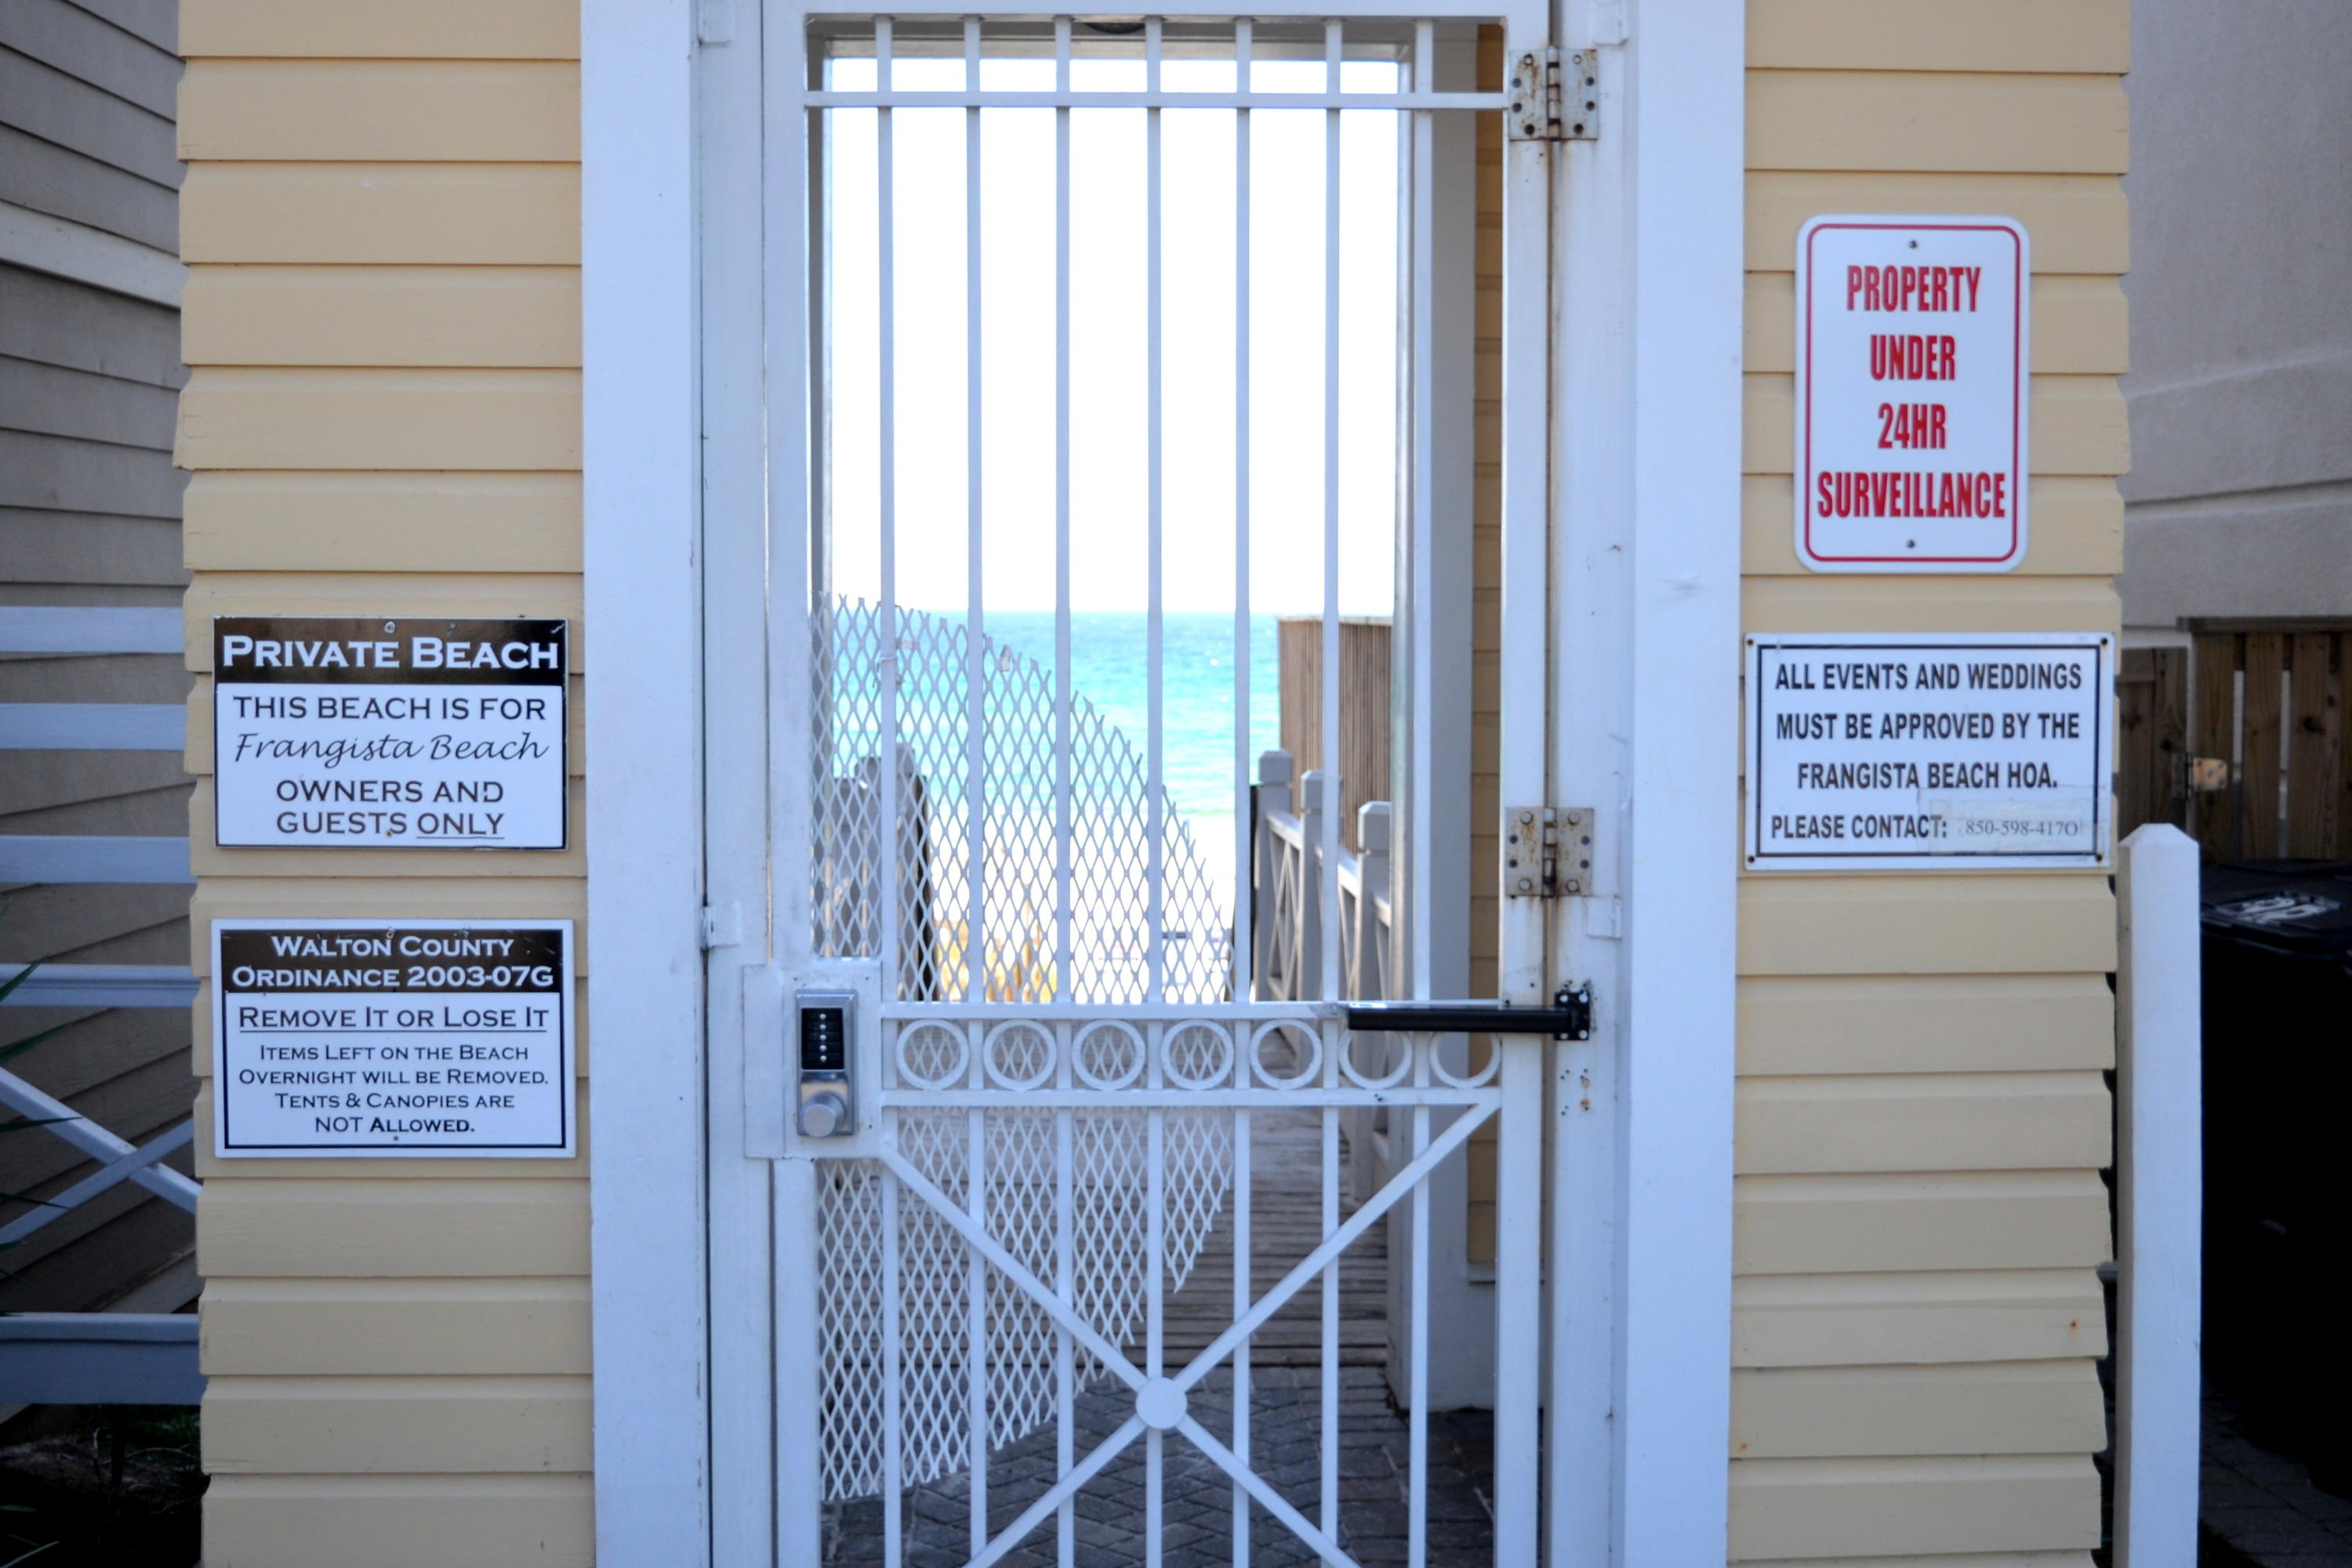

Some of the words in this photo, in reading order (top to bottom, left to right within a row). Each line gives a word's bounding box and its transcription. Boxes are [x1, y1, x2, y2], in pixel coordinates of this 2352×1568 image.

[1846, 265, 1981, 312] PROPERTY
[1870, 335, 1955, 381] UNDER
[1878, 403, 1946, 449] 24HR
[1817, 471, 2005, 518] SURVEILLANCE
[223, 635, 400, 668] PRIVATE
[412, 637, 558, 669] BEACH
[1775, 663, 1815, 689] ALL
[1823, 663, 1907, 689] EVENTS
[1915, 663, 1959, 689] AND
[1968, 663, 2082, 690] WEDDINGS
[234, 696, 307, 718] THIS
[318, 697, 430, 720] BEACH
[441, 698, 469, 720] IS
[480, 698, 546, 720] FOR
[1777, 713, 1838, 739] MUST
[1845, 713, 1872, 739] BE
[1879, 713, 1994, 739] APPROVED
[2002, 713, 2031, 739] BY
[2038, 713, 2080, 739] THE
[234, 732, 424, 768] Frangista
[430, 731, 549, 760] Beach
[1798, 762, 1919, 789] FRANGISTA
[1927, 762, 1999, 789] BEACH
[2007, 763, 2057, 789] HOA.
[276, 779, 423, 802] OWNERS
[433, 781, 503, 803] AND
[276, 811, 407, 834] GUESTS
[416, 812, 505, 835] ONLY
[1771, 815, 1843, 838] PLEASE
[1852, 815, 1947, 839] CONTACT:
[271, 936, 391, 956] WALTON
[399, 936, 514, 957] COUNTY
[232, 967, 400, 987] ORDINANCE
[407, 966, 554, 987] 2003-07G
[239, 1007, 357, 1028] REMOVE
[365, 1007, 389, 1028] IT
[397, 1010, 434, 1028] OR
[443, 1007, 517, 1028] LOSE
[525, 1007, 549, 1028] IT
[260, 1045, 318, 1061] ITEMS
[325, 1045, 375, 1061] LEFT
[381, 1047, 408, 1061] ON
[415, 1047, 452, 1061] THE
[459, 1046, 528, 1061] BEACH
[239, 1069, 356, 1085] OVERNIGHT
[362, 1071, 409, 1084] WILL
[416, 1072, 441, 1085] BE
[448, 1069, 548, 1085] REMOVED.
[275, 1094, 339, 1109] TENTS
[346, 1093, 360, 1109] &
[366, 1094, 469, 1109] CANOPIES
[475, 1095, 515, 1109] ARE
[315, 1117, 363, 1133] NOT
[370, 1117, 475, 1133] ALLOWED.
